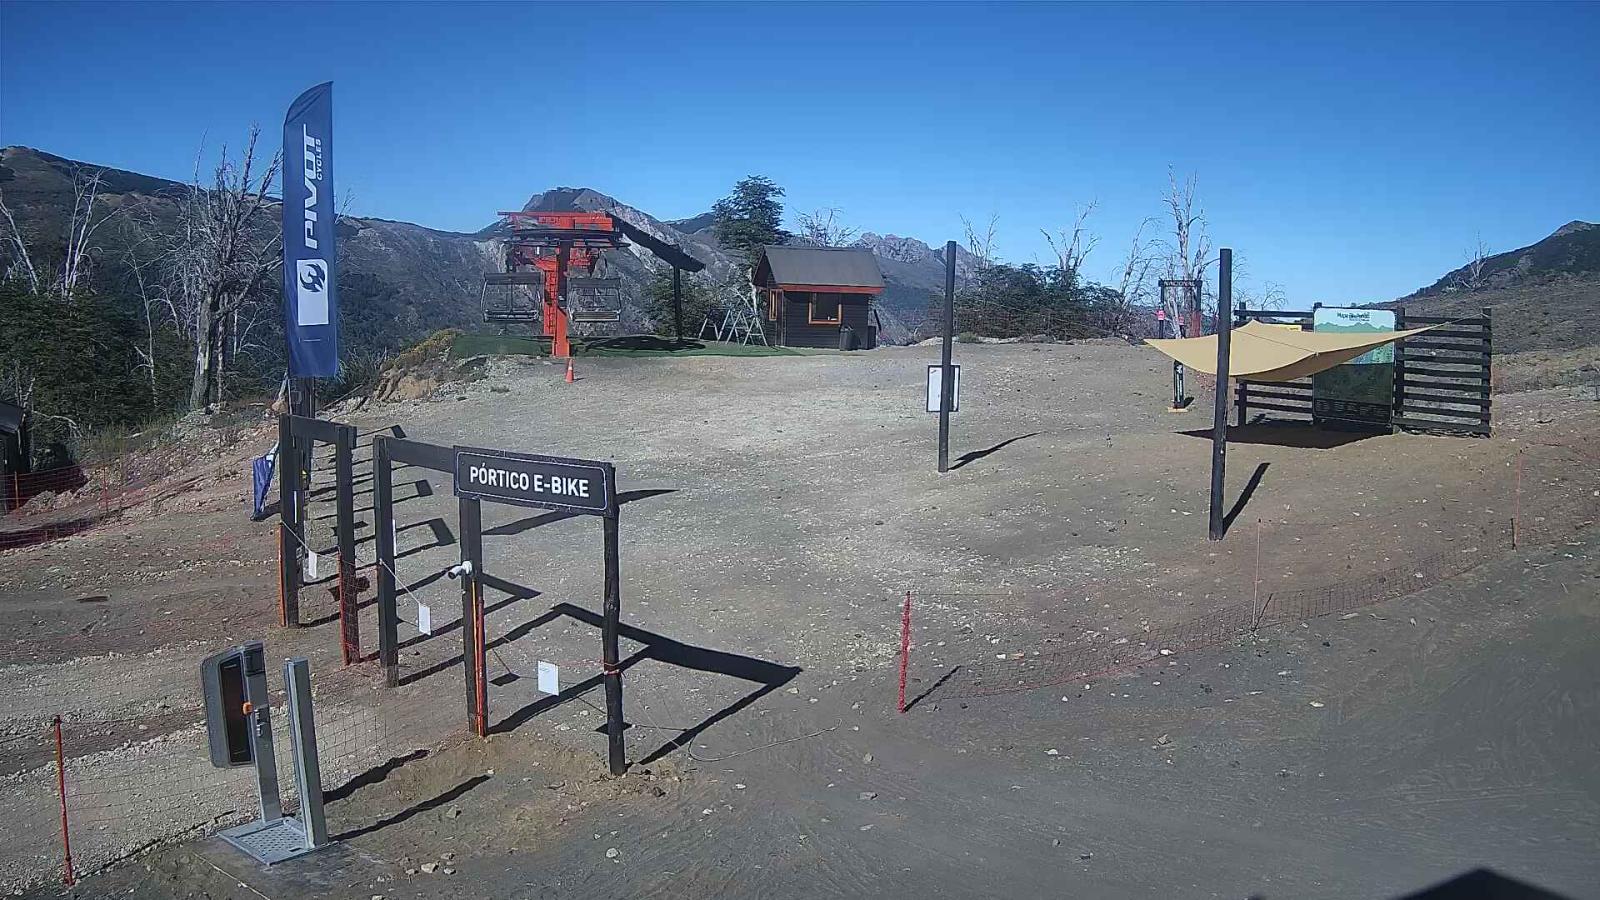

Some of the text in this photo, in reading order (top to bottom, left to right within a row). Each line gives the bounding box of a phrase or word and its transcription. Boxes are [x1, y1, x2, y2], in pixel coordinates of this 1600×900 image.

[315, 139, 323, 181] CYCLES
[303, 123, 318, 250] PIVOT
[469, 462, 590, 498] PÓRTICO E-BIKE
